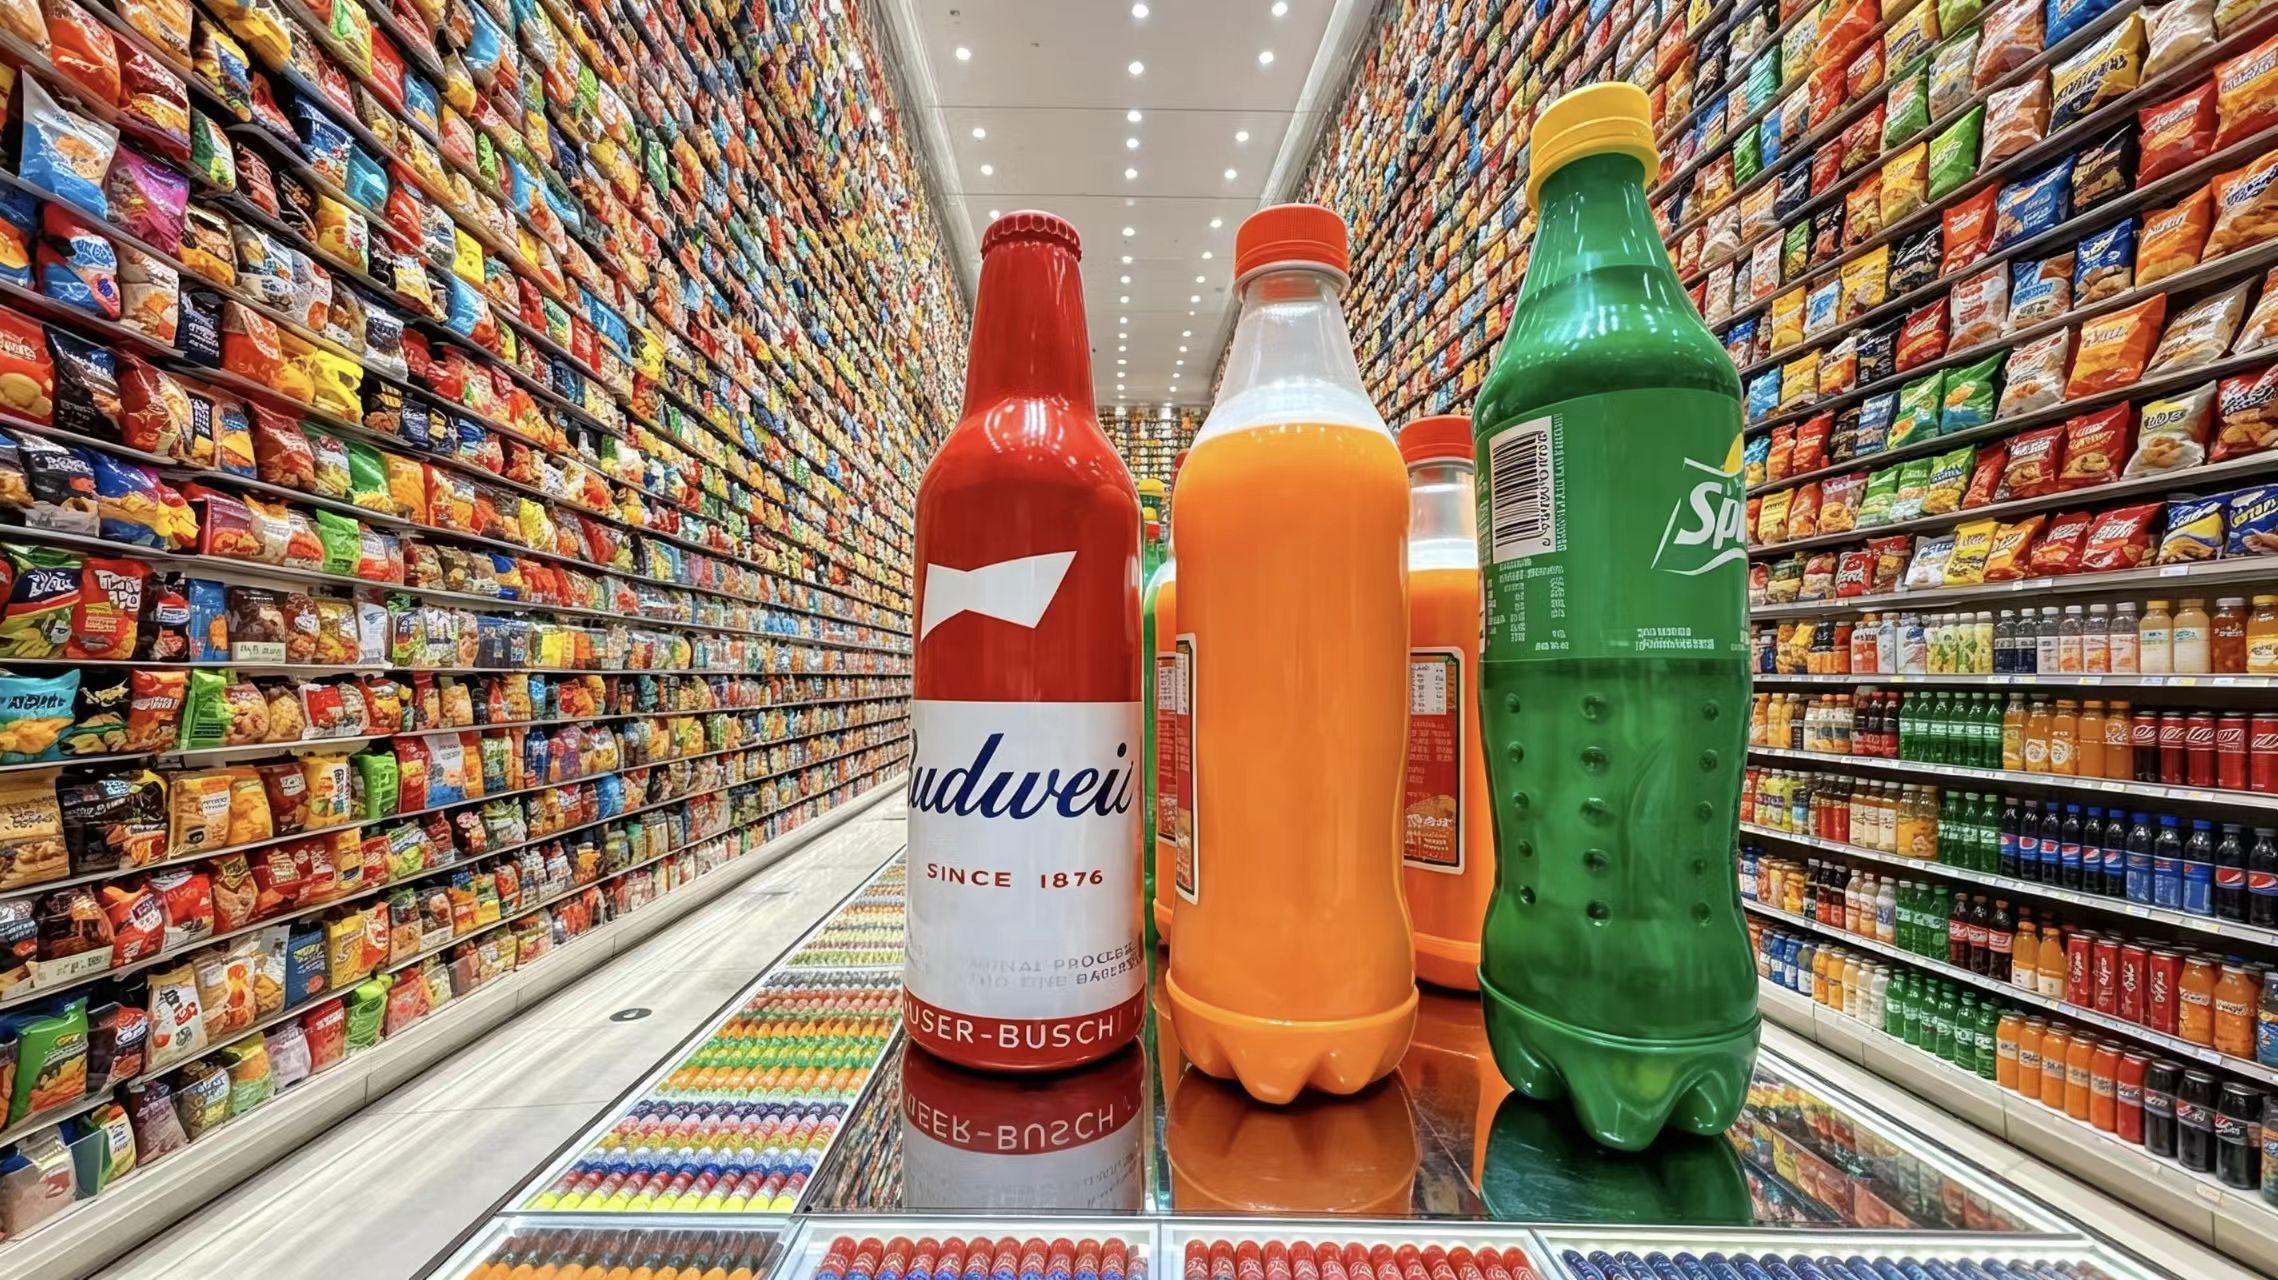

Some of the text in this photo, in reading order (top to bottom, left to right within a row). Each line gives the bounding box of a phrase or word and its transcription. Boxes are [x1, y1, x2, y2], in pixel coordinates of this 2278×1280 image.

[907, 728, 1134, 820] udwei
[927, 863, 1104, 889] SINCE 1876
